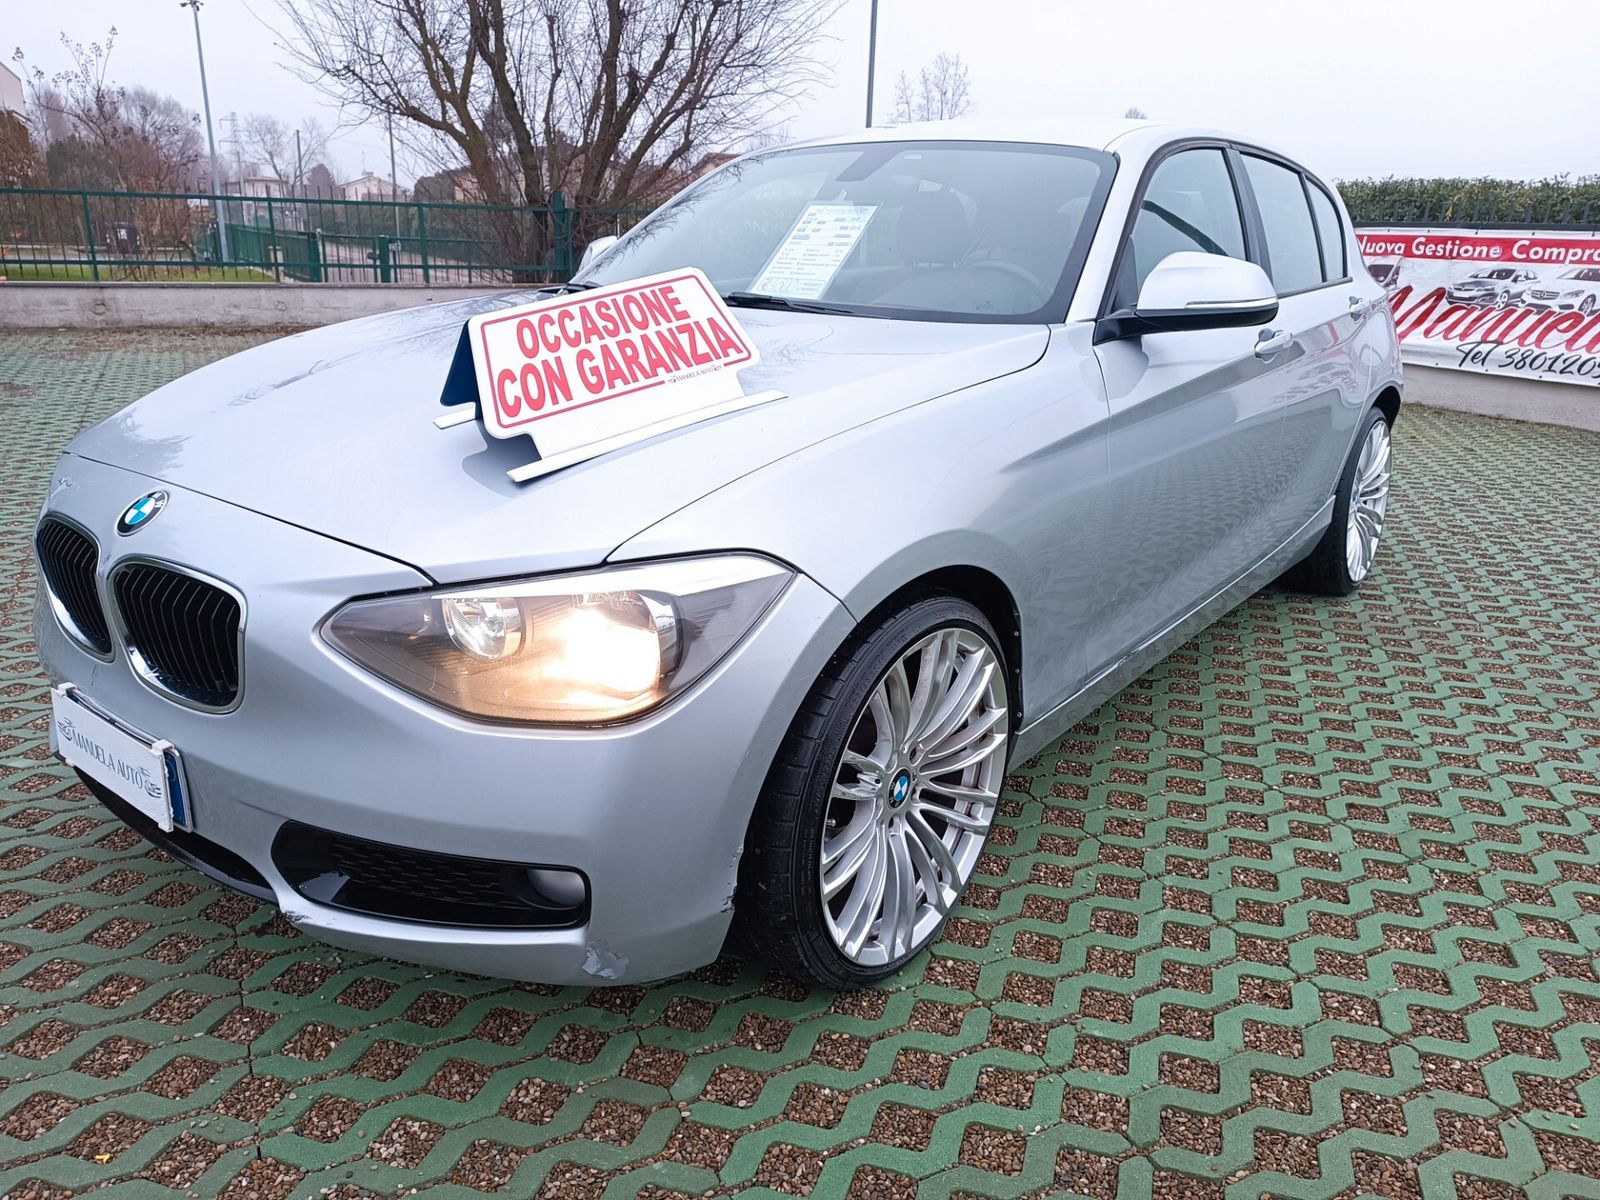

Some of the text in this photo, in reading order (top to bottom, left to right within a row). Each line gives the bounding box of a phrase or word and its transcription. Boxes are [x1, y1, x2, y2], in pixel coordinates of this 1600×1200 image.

[1358, 235, 1406, 255] Nuova
[1411, 236, 1502, 259] Gestione
[516, 286, 691, 359] OCCASIONE
[497, 317, 744, 418] CON GARANZIA
[1456, 340, 1503, 368] Tel
[71, 729, 143, 789] MANUELA AUTO
